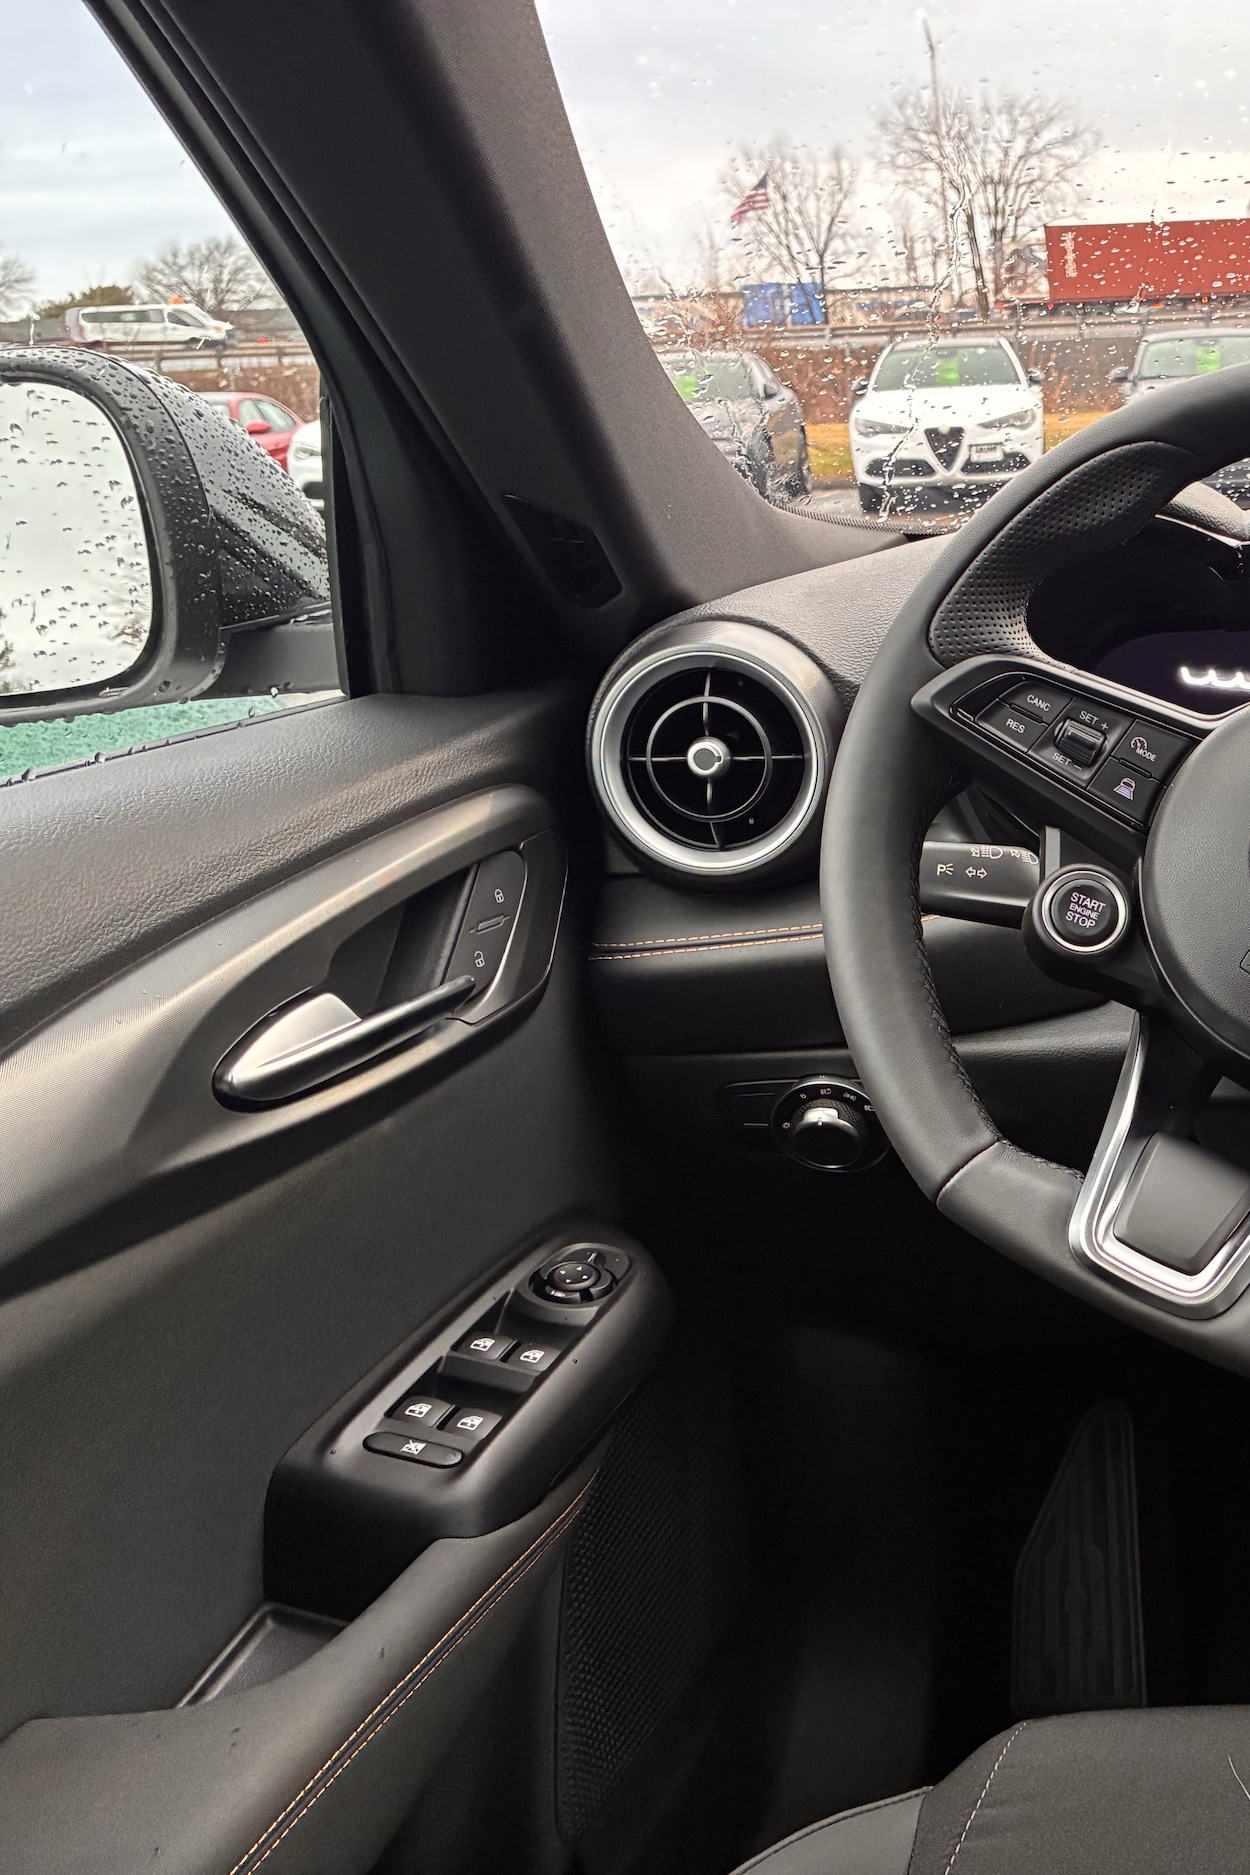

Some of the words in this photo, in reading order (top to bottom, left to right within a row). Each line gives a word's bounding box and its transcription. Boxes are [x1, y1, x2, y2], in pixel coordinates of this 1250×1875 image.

[1027, 694, 1051, 712] CANC
[1079, 710, 1099, 725] SET
[1006, 718, 1026, 734] RES
[1052, 752, 1072, 767] SET
[1136, 748, 1157, 762] MODE
[1070, 892, 1106, 912] START
[1069, 902, 1100, 920] ENGINE
[1066, 911, 1096, 928] STOP
